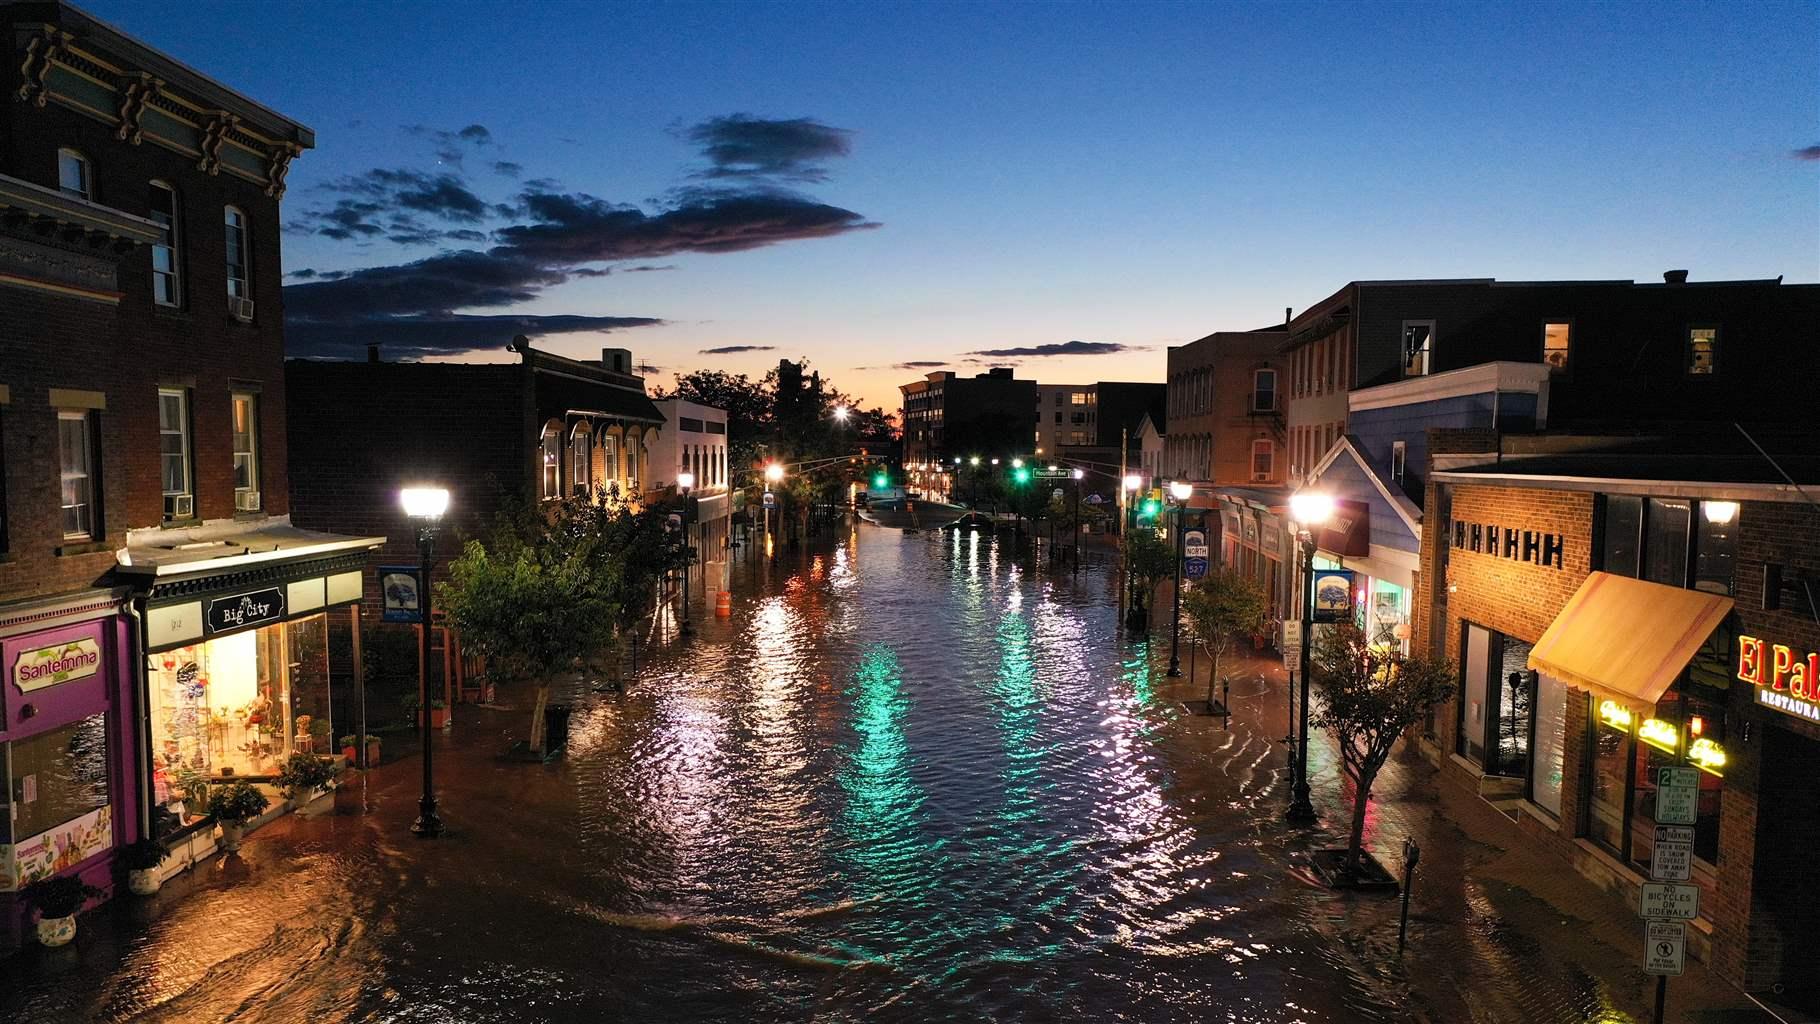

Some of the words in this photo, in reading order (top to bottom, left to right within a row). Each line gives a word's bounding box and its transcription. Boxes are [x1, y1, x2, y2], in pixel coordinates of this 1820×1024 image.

[1190, 565, 1203, 573] 527
[223, 608, 244, 624] Big
[247, 602, 270, 616] City
[20, 652, 97, 681] Santemma
[1737, 635, 1766, 685] El
[1772, 644, 1820, 703] Pal
[1761, 689, 1820, 720] RESTAURA
[1661, 770, 1670, 785] 2
[1664, 805, 1690, 813] SUNDAYS
[1656, 830, 1666, 841] NO
[1667, 831, 1691, 840] PARKING
[1648, 893, 1691, 902] BICYCLES
[1648, 908, 1690, 917] SIDEWALK
